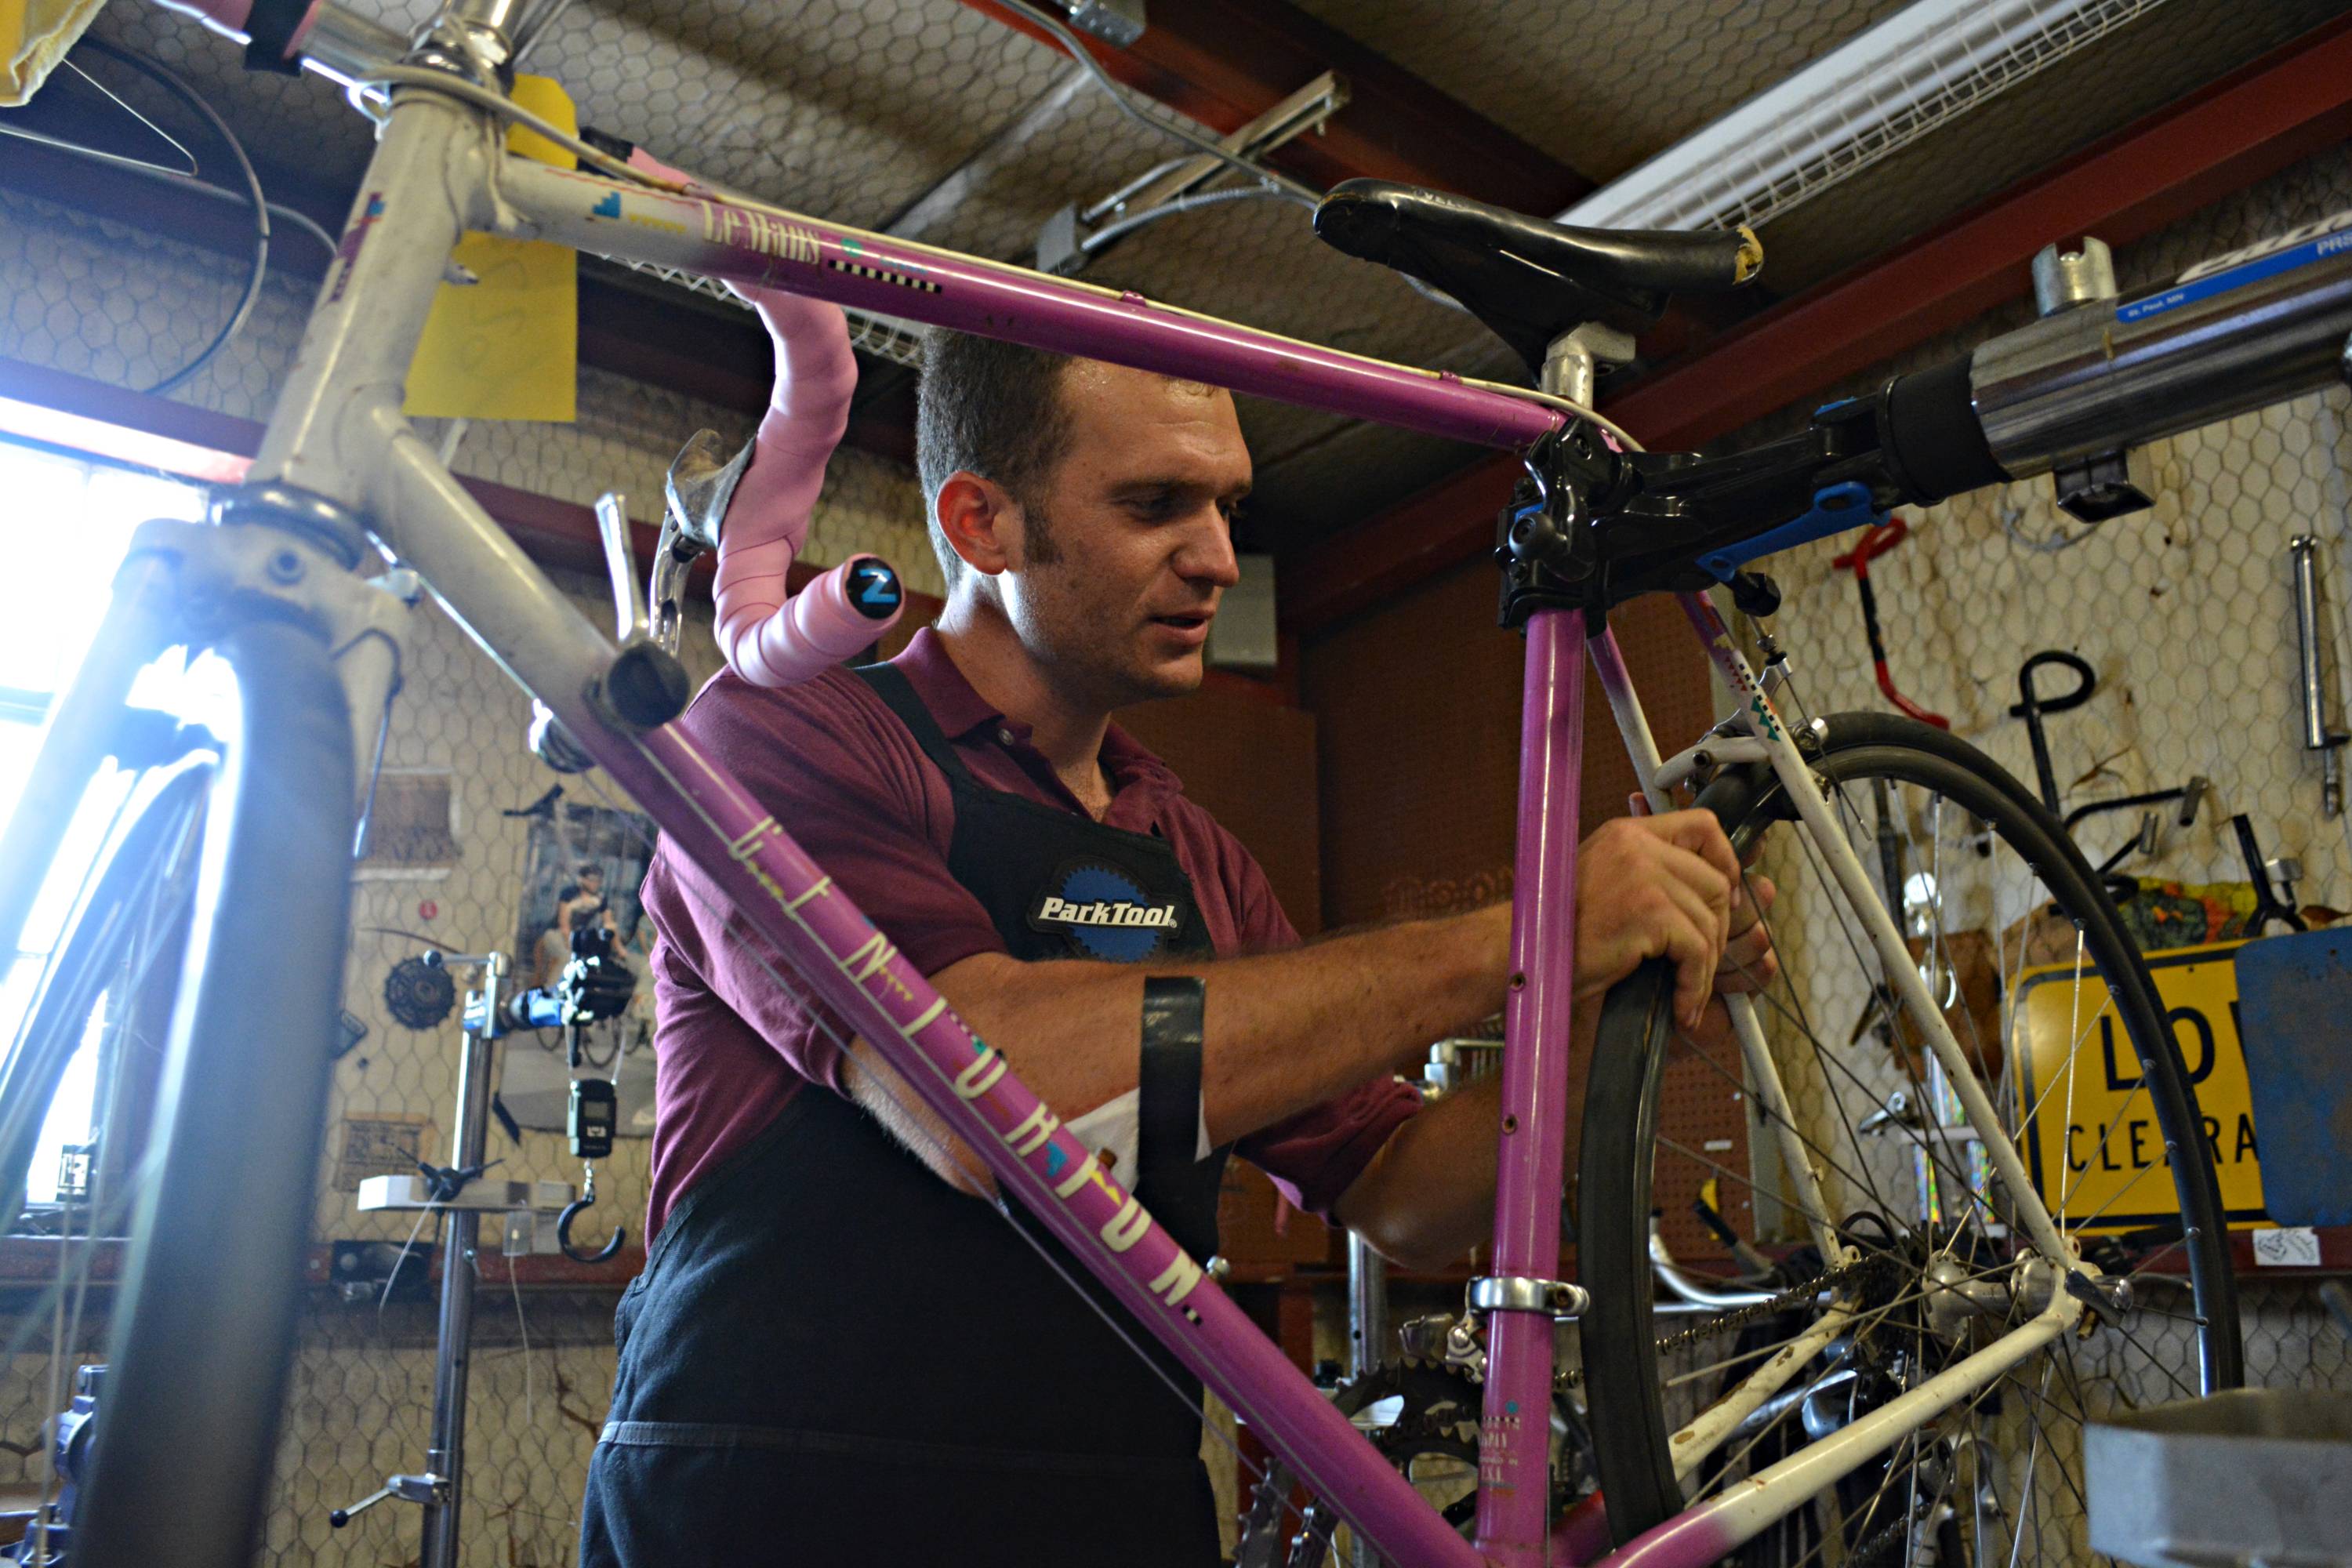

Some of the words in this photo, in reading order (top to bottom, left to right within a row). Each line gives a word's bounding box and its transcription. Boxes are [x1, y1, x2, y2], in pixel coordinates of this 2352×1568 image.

[729, 817, 1201, 1306] CENTURION
[2100, 1000, 2250, 1091] LO
[2067, 1112, 2259, 1171] CLERA
